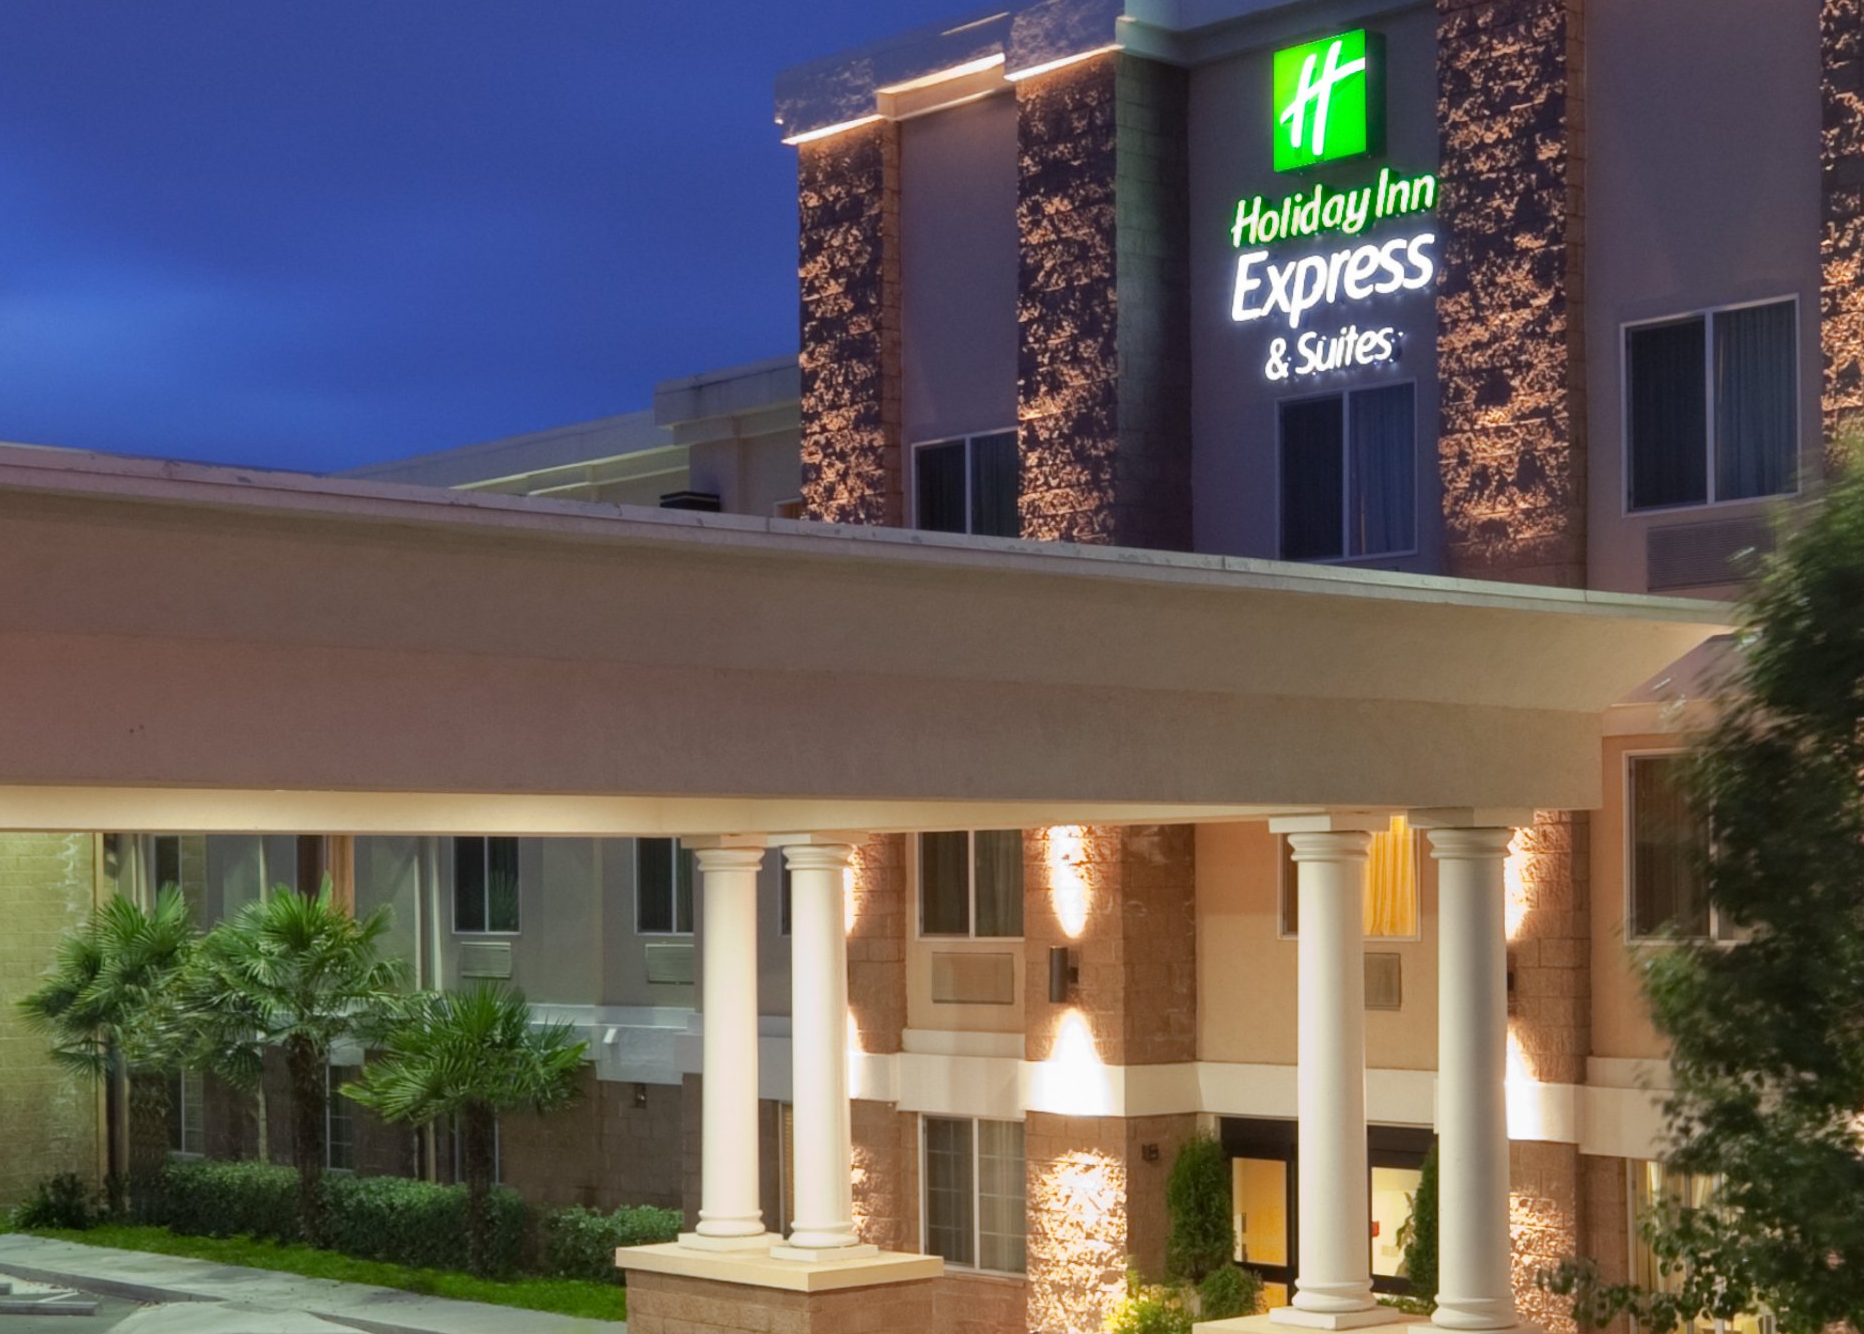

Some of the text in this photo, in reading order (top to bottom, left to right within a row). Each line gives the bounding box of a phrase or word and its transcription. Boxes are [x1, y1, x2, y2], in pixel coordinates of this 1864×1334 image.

[1231, 168, 1435, 247] Holiday Inn
[1231, 233, 1435, 329] Express
[1265, 325, 1394, 381] & Suites
